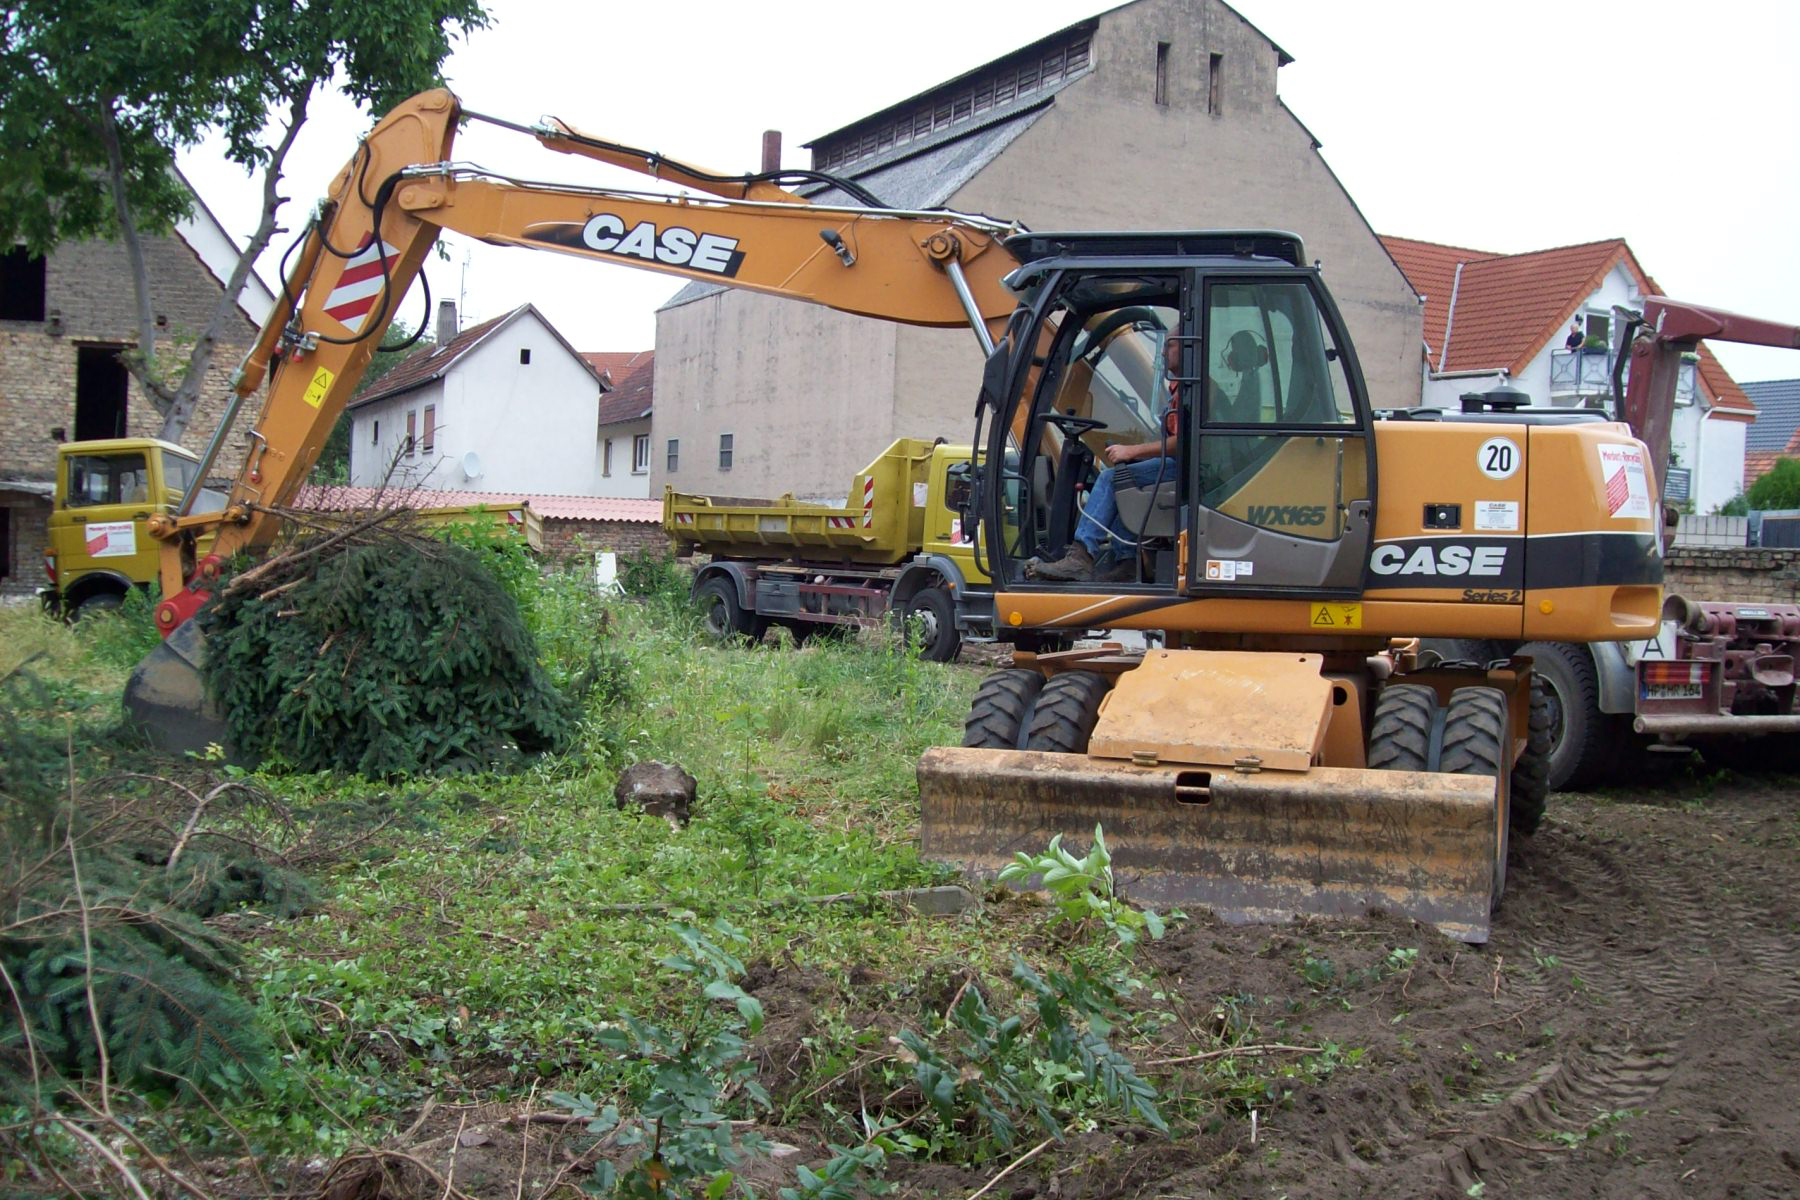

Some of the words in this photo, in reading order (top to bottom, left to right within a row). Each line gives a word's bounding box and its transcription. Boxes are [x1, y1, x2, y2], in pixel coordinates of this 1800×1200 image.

[583, 213, 739, 273] CASE
[1486, 445, 1512, 472] 20
[1248, 505, 1327, 525] WX165
[1370, 545, 1508, 576] CASE
[1462, 589, 1507, 603] Series
[1508, 590, 1521, 602] 2
[1642, 638, 1664, 658] A
